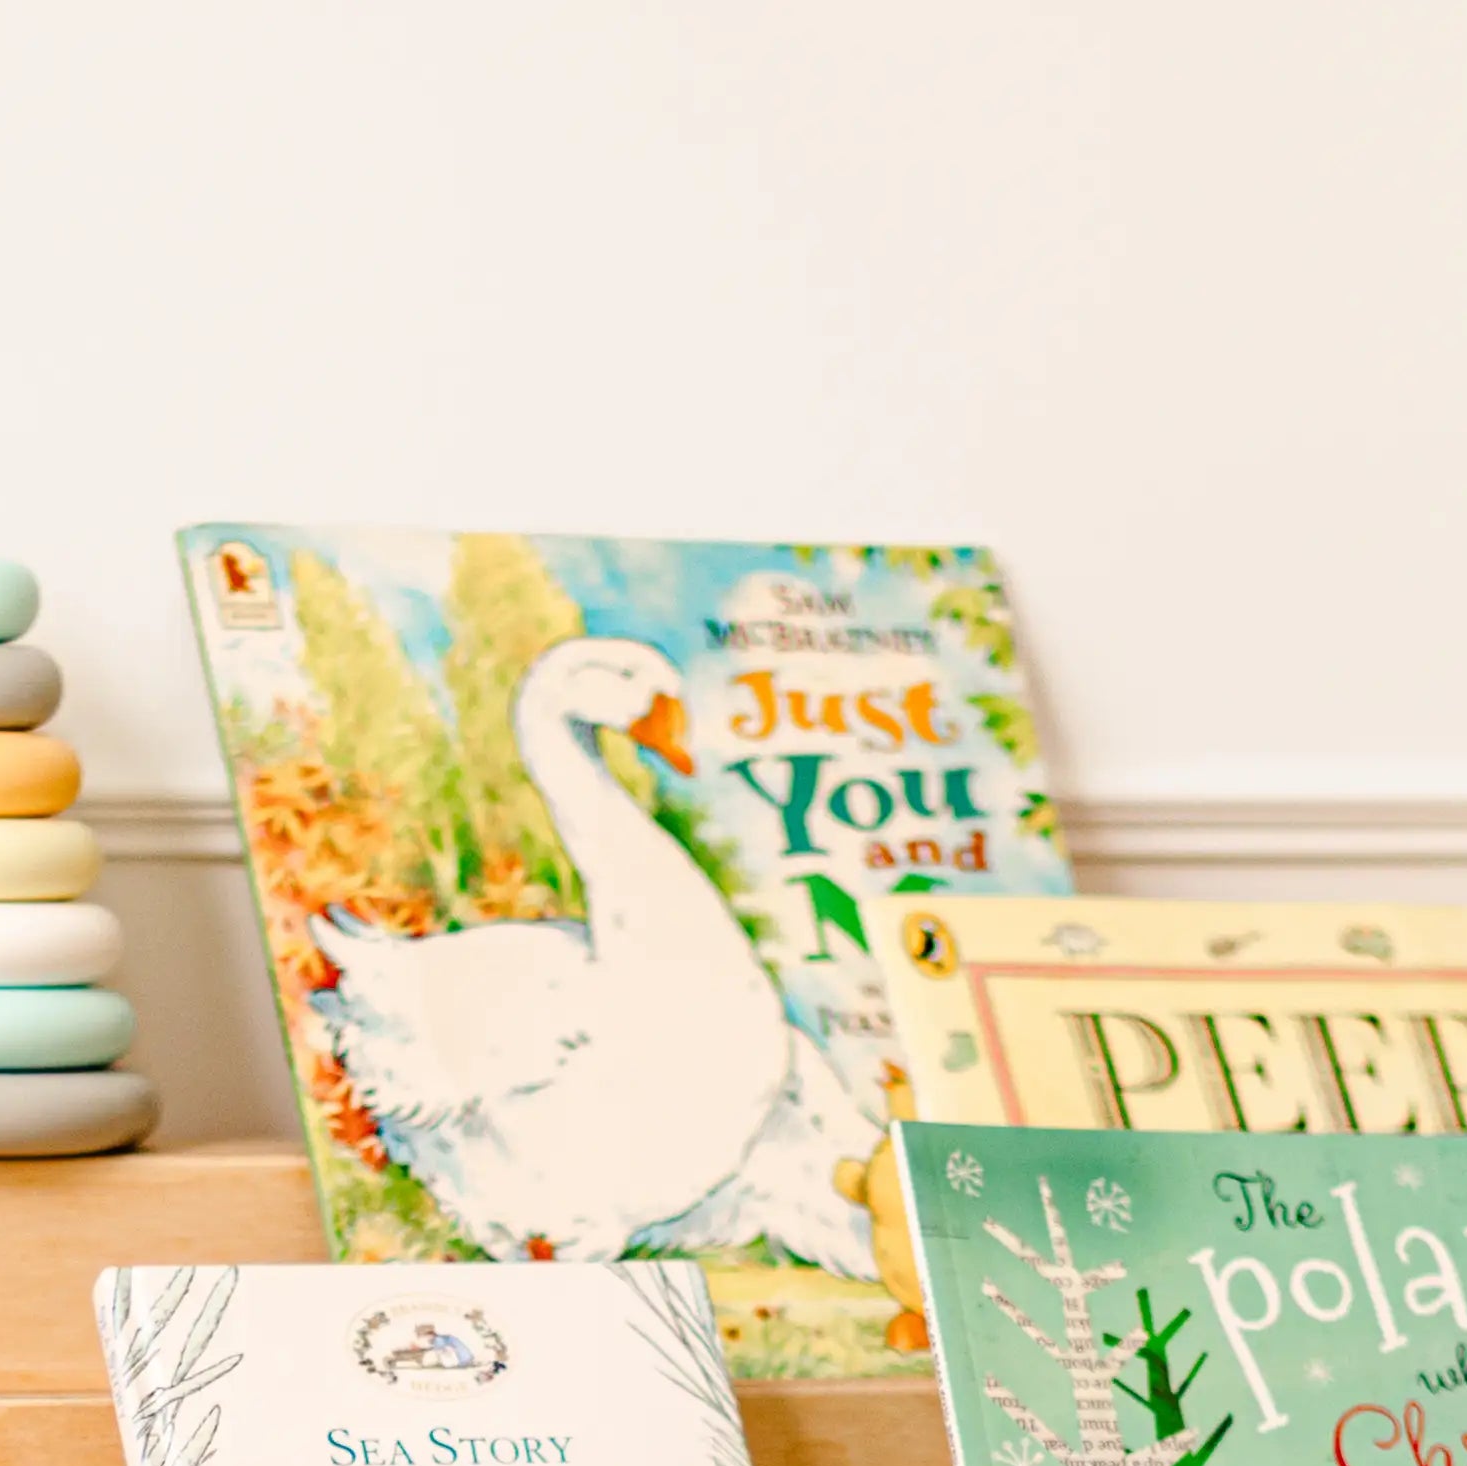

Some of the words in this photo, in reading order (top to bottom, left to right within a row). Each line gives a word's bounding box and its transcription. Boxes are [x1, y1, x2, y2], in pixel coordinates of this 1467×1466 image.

[728, 670, 959, 752] Just
[723, 754, 989, 856] You
[864, 829, 989, 873] and
[1213, 1171, 1323, 1232] The
